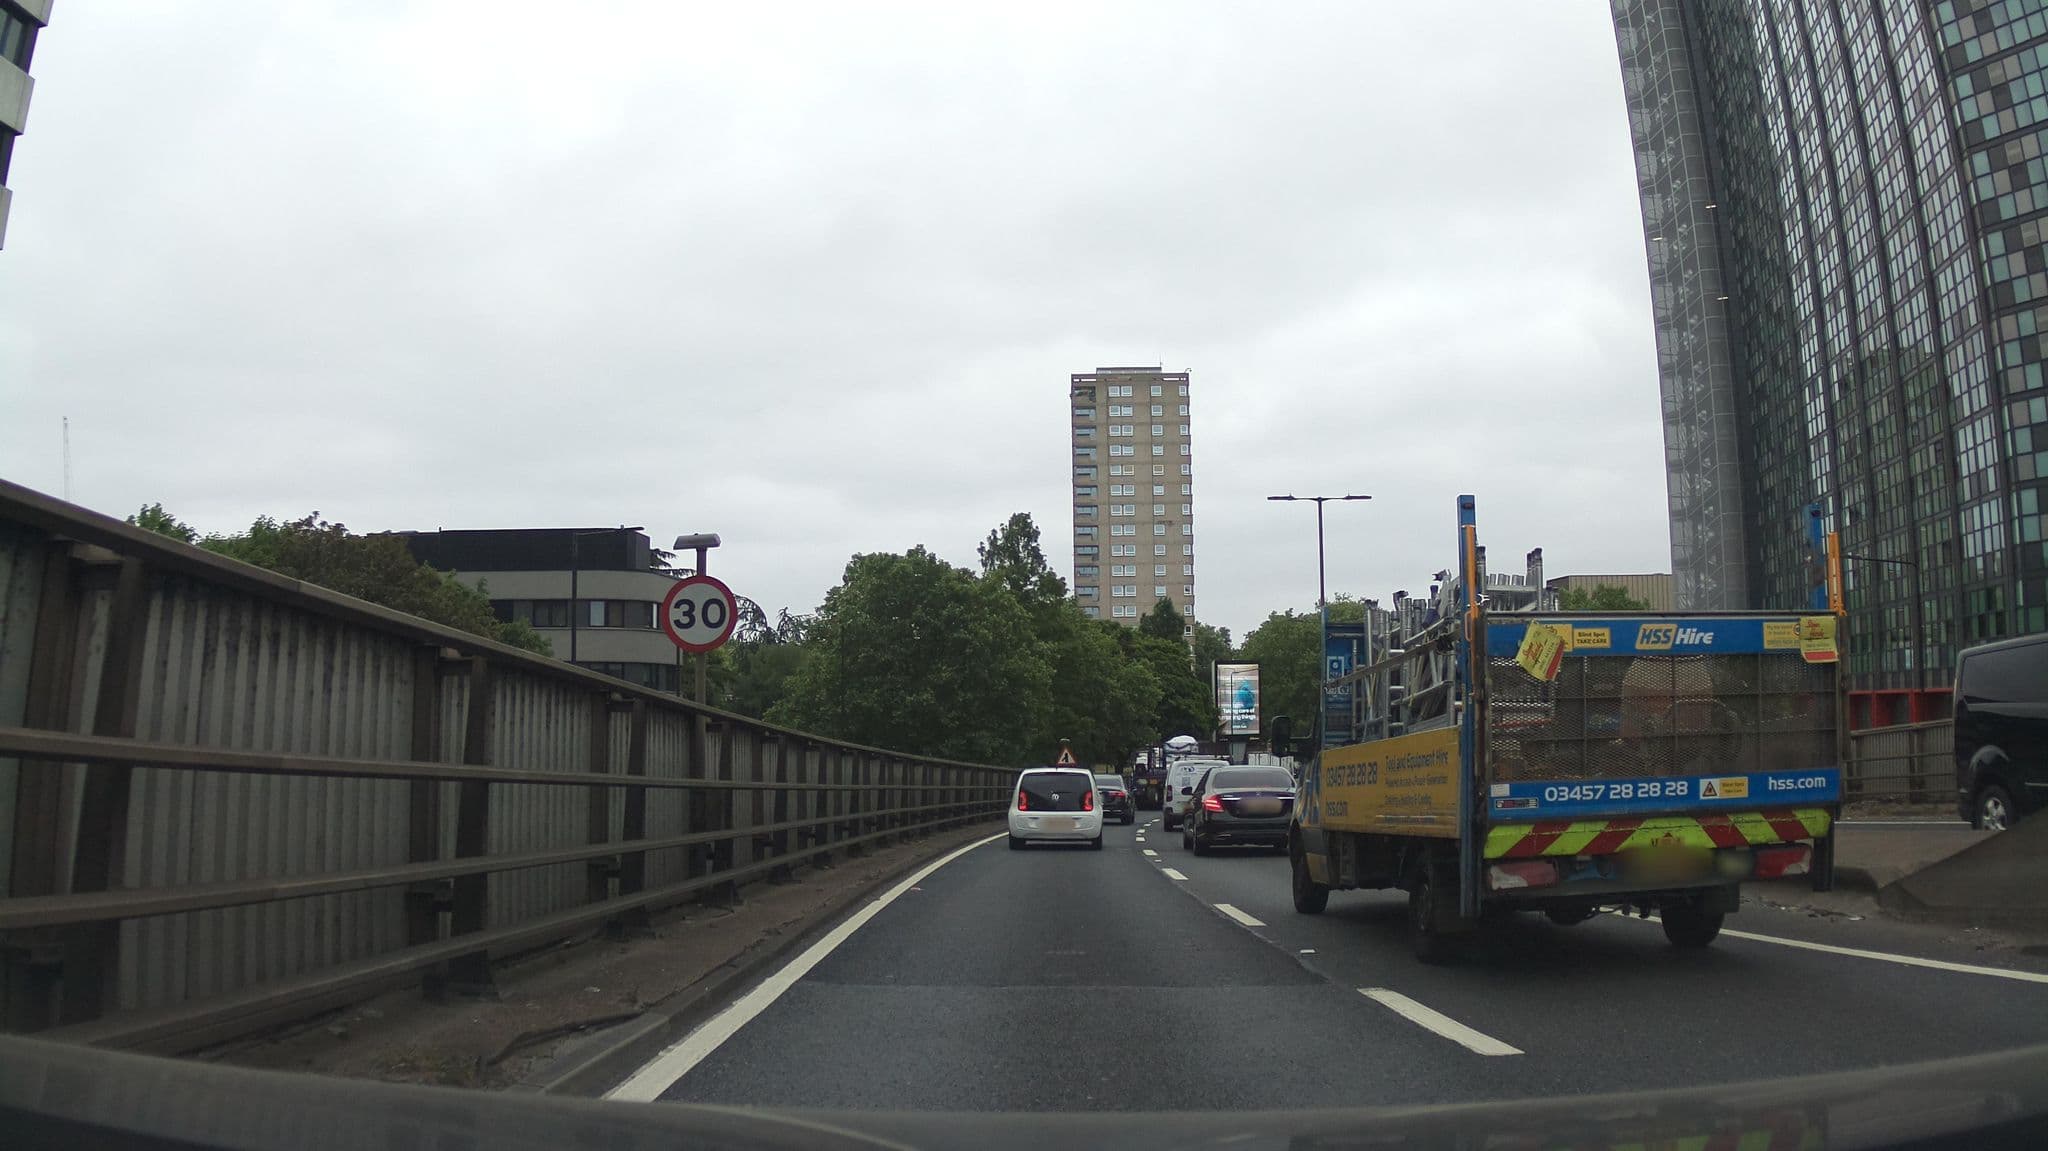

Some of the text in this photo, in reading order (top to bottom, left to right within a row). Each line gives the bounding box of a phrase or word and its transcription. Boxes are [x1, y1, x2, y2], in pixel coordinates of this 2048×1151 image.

[673, 598, 726, 629] 30
[1639, 626, 1714, 645] HSS Hire
[1545, 781, 1688, 801] 03457 28 28 28
[1768, 776, 1826, 790] hss.com
